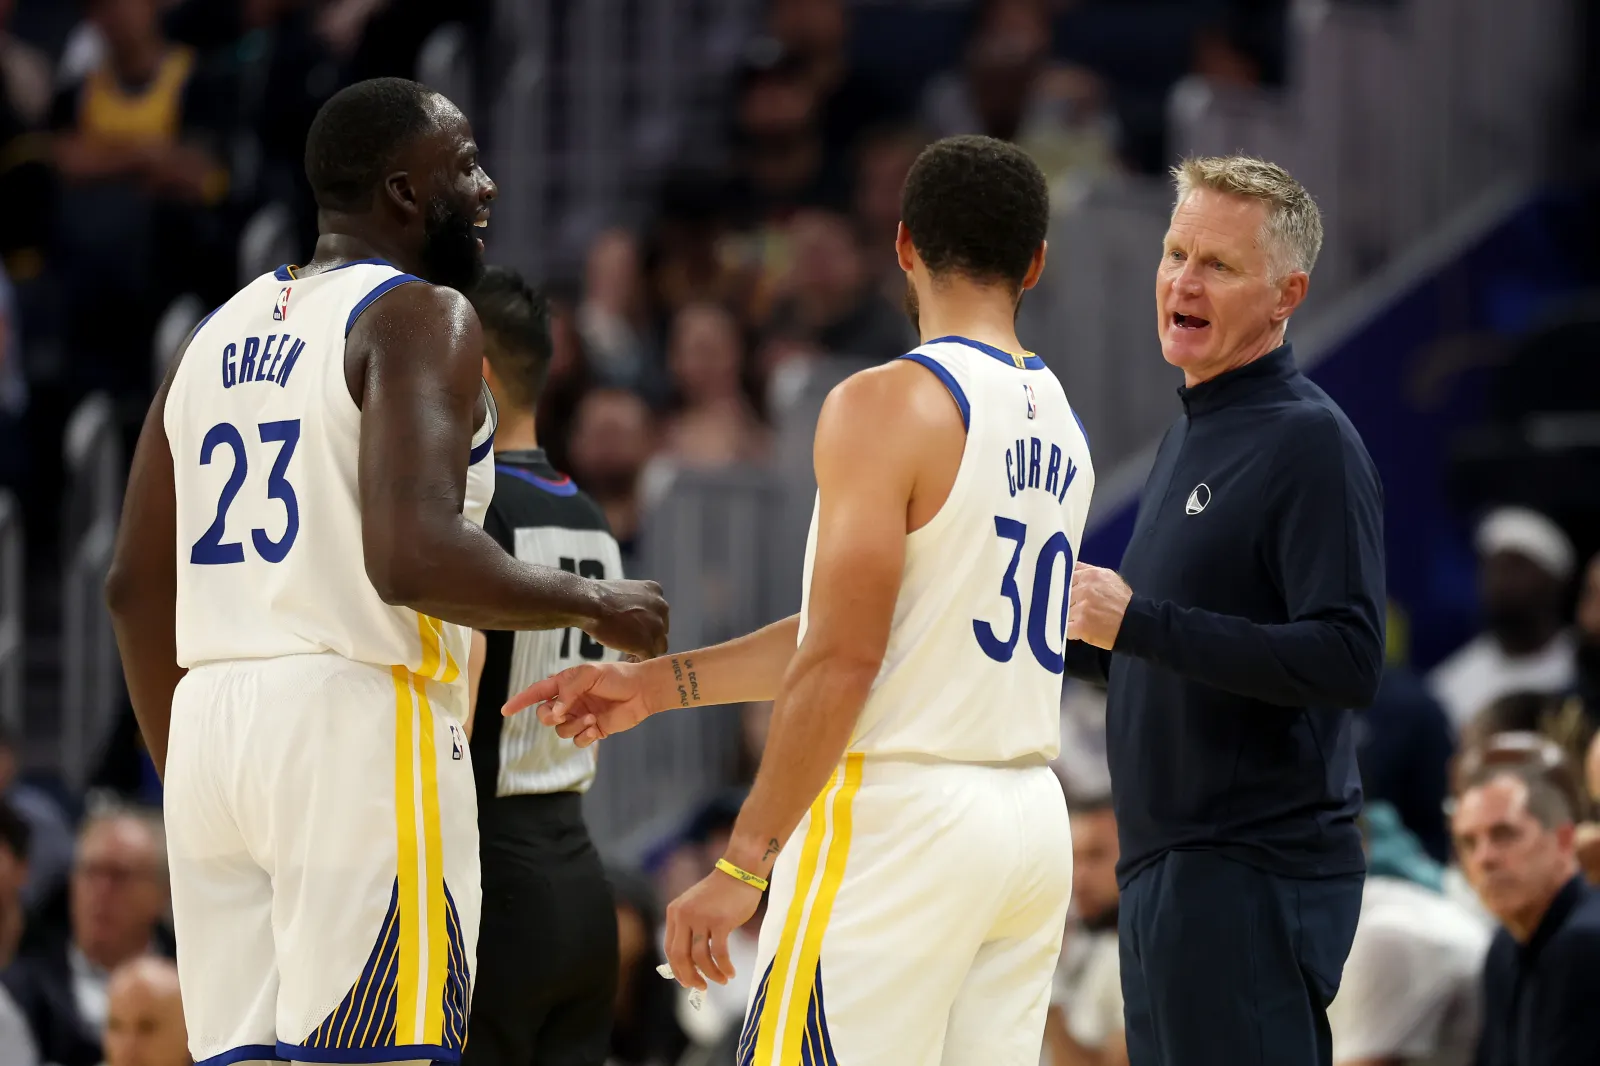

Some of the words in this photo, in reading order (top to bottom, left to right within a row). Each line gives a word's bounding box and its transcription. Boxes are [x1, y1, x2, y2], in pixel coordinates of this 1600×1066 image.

[222, 334, 306, 389] GREEN
[190, 419, 301, 565] 23
[1005, 437, 1078, 505] CURRY
[972, 515, 1074, 675] 30
